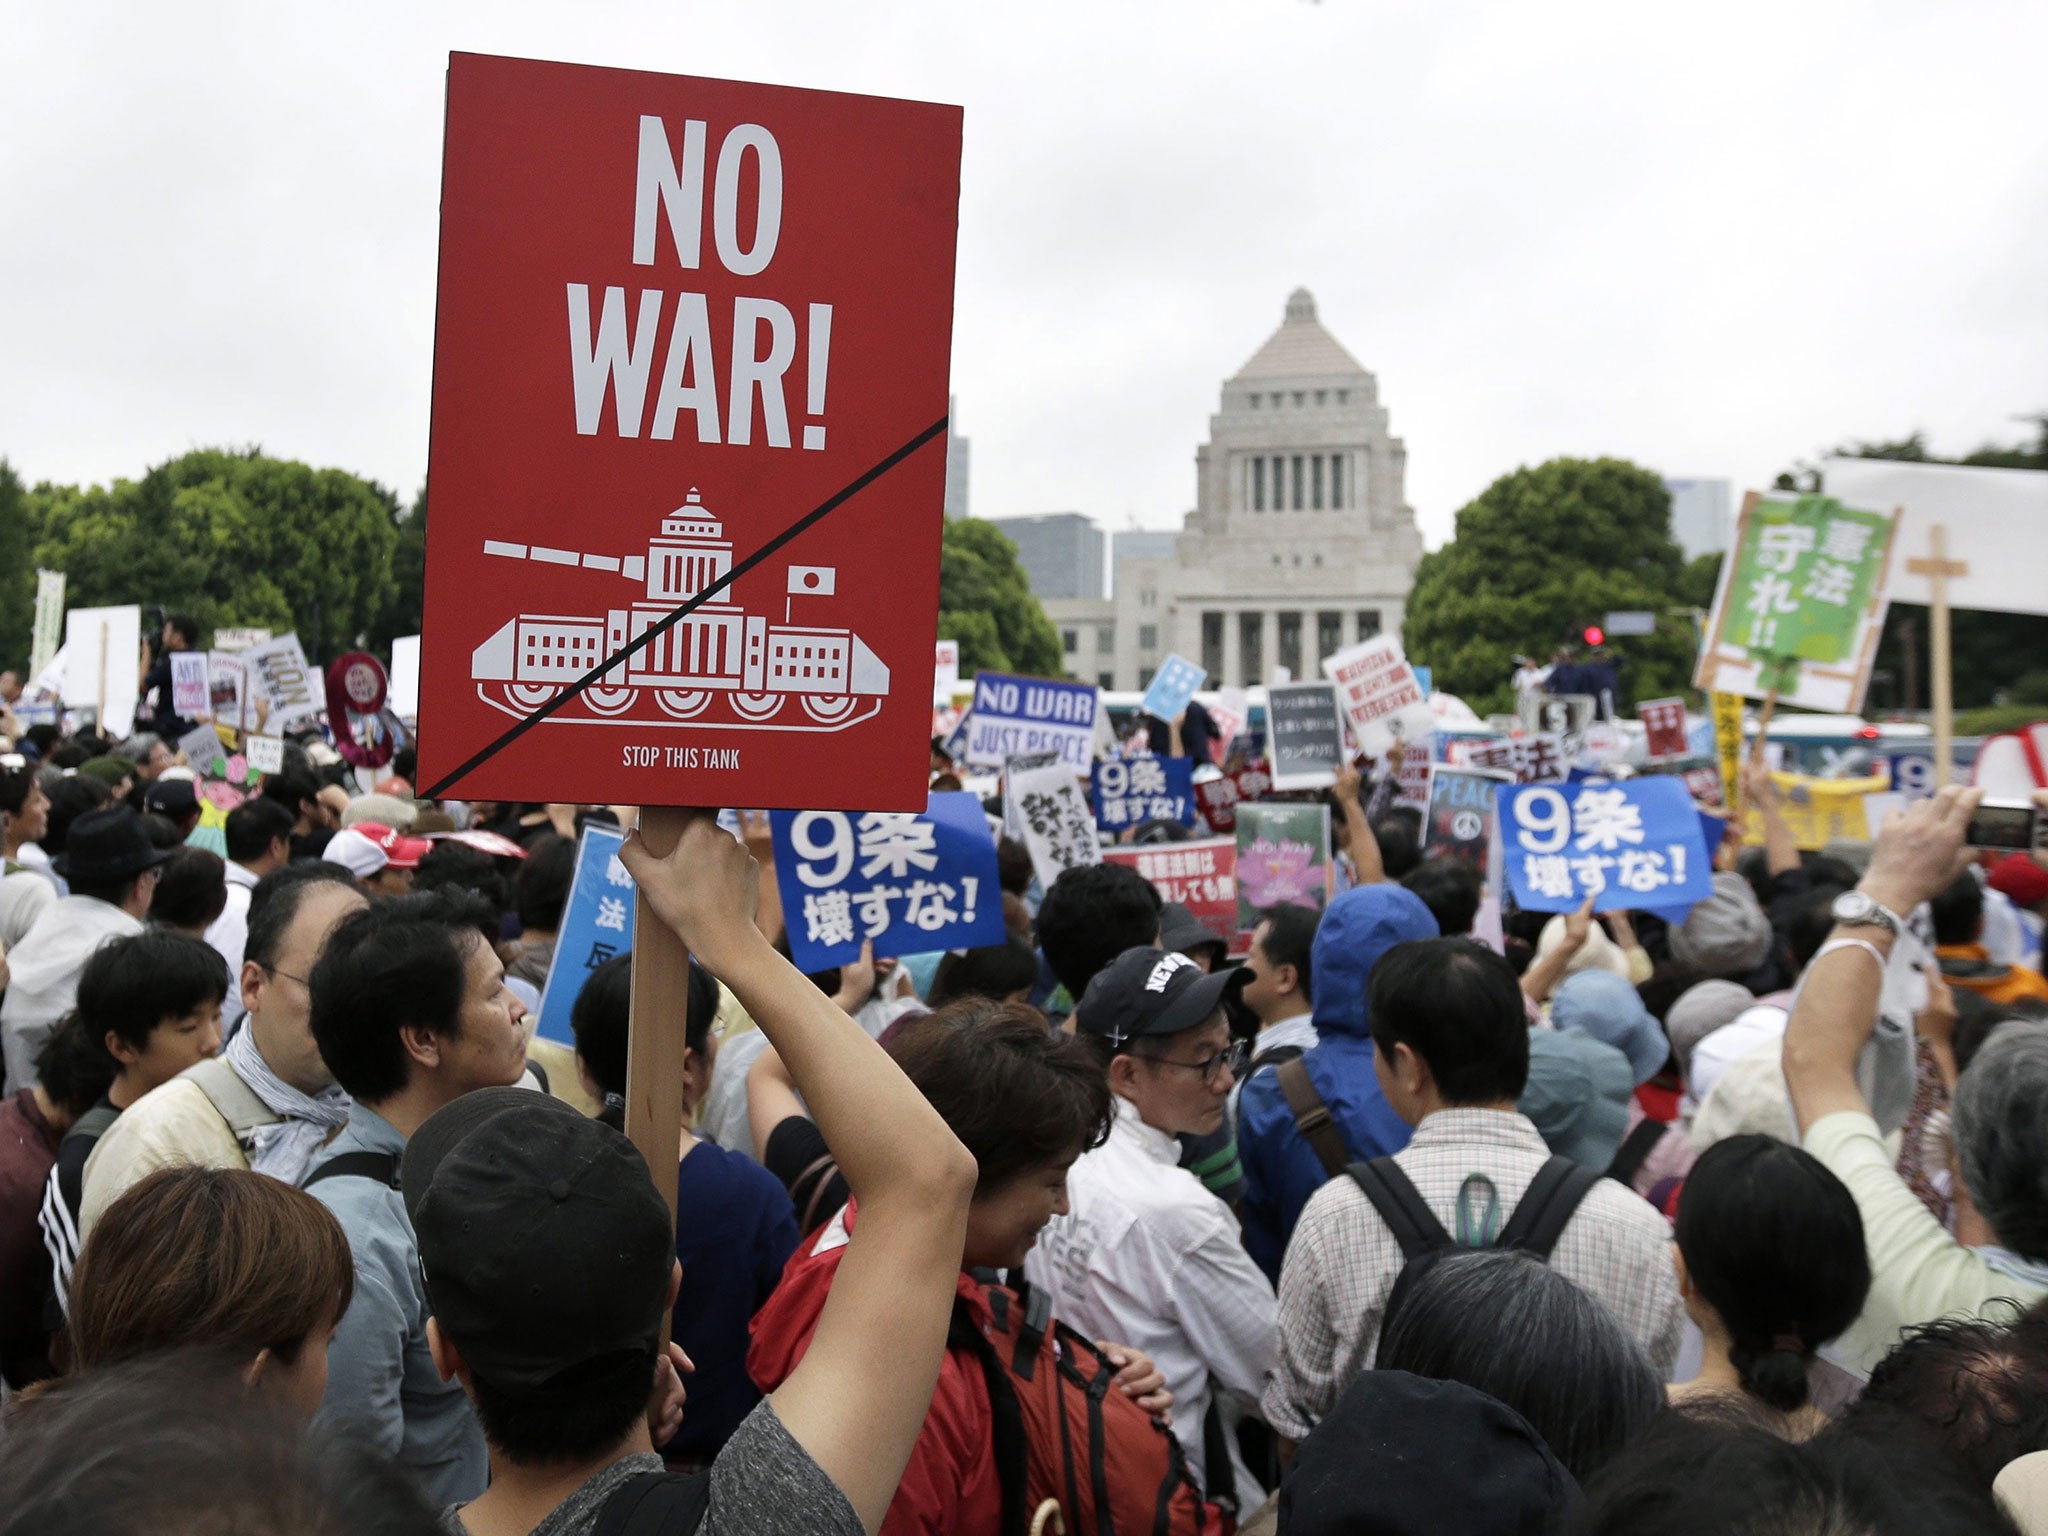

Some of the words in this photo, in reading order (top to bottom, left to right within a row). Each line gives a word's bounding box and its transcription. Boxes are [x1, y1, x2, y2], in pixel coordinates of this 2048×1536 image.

[632, 114, 783, 276] NO
[566, 282, 834, 451] WAR!
[1803, 519, 1874, 606] 憲法
[977, 681, 1020, 715] NO
[1025, 687, 1092, 723] WAR
[623, 746, 660, 767] STOP
[665, 747, 698, 768] THIS
[702, 748, 740, 769] TANK
[973, 726, 1022, 755] JUST
[1098, 760, 1167, 798] 9条
[791, 811, 938, 888] 9条
[1513, 787, 1645, 853] 9条
[1524, 844, 1687, 898] 壊すな!
[803, 877, 979, 947] 壊すな!
